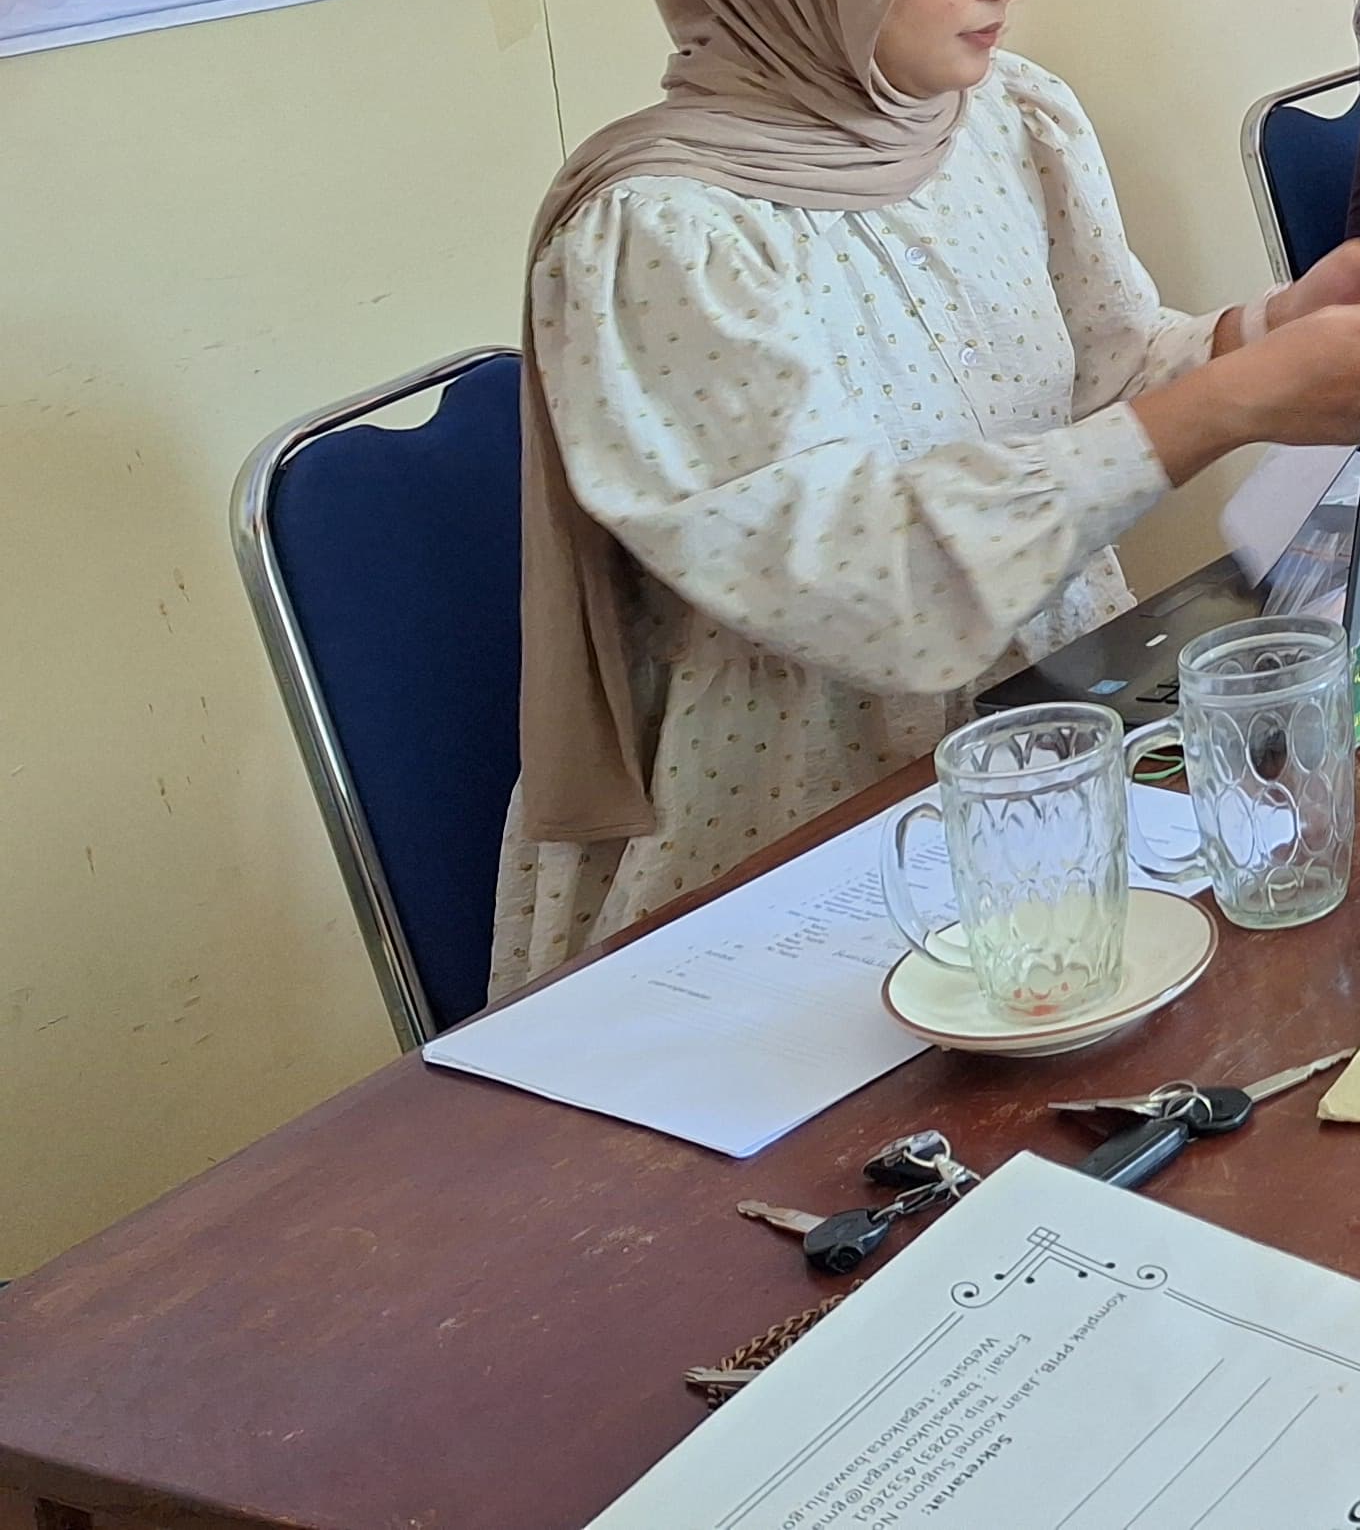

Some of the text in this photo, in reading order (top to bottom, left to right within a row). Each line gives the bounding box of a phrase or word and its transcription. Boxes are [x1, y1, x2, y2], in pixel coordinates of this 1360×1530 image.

[1069, 1292, 1127, 1342] Komplek
[941, 1337, 1000, 1388] Website
[984, 1333, 1032, 1375] E-mail
[1001, 1376, 1040, 1411] Jalan
[853, 1394, 999, 1523] Telp. (0283) 4532661
[951, 1411, 1007, 1460] Kolonel
[895, 1458, 956, 1511] Sugiono
[921, 1434, 1013, 1516] Sekretariat:
